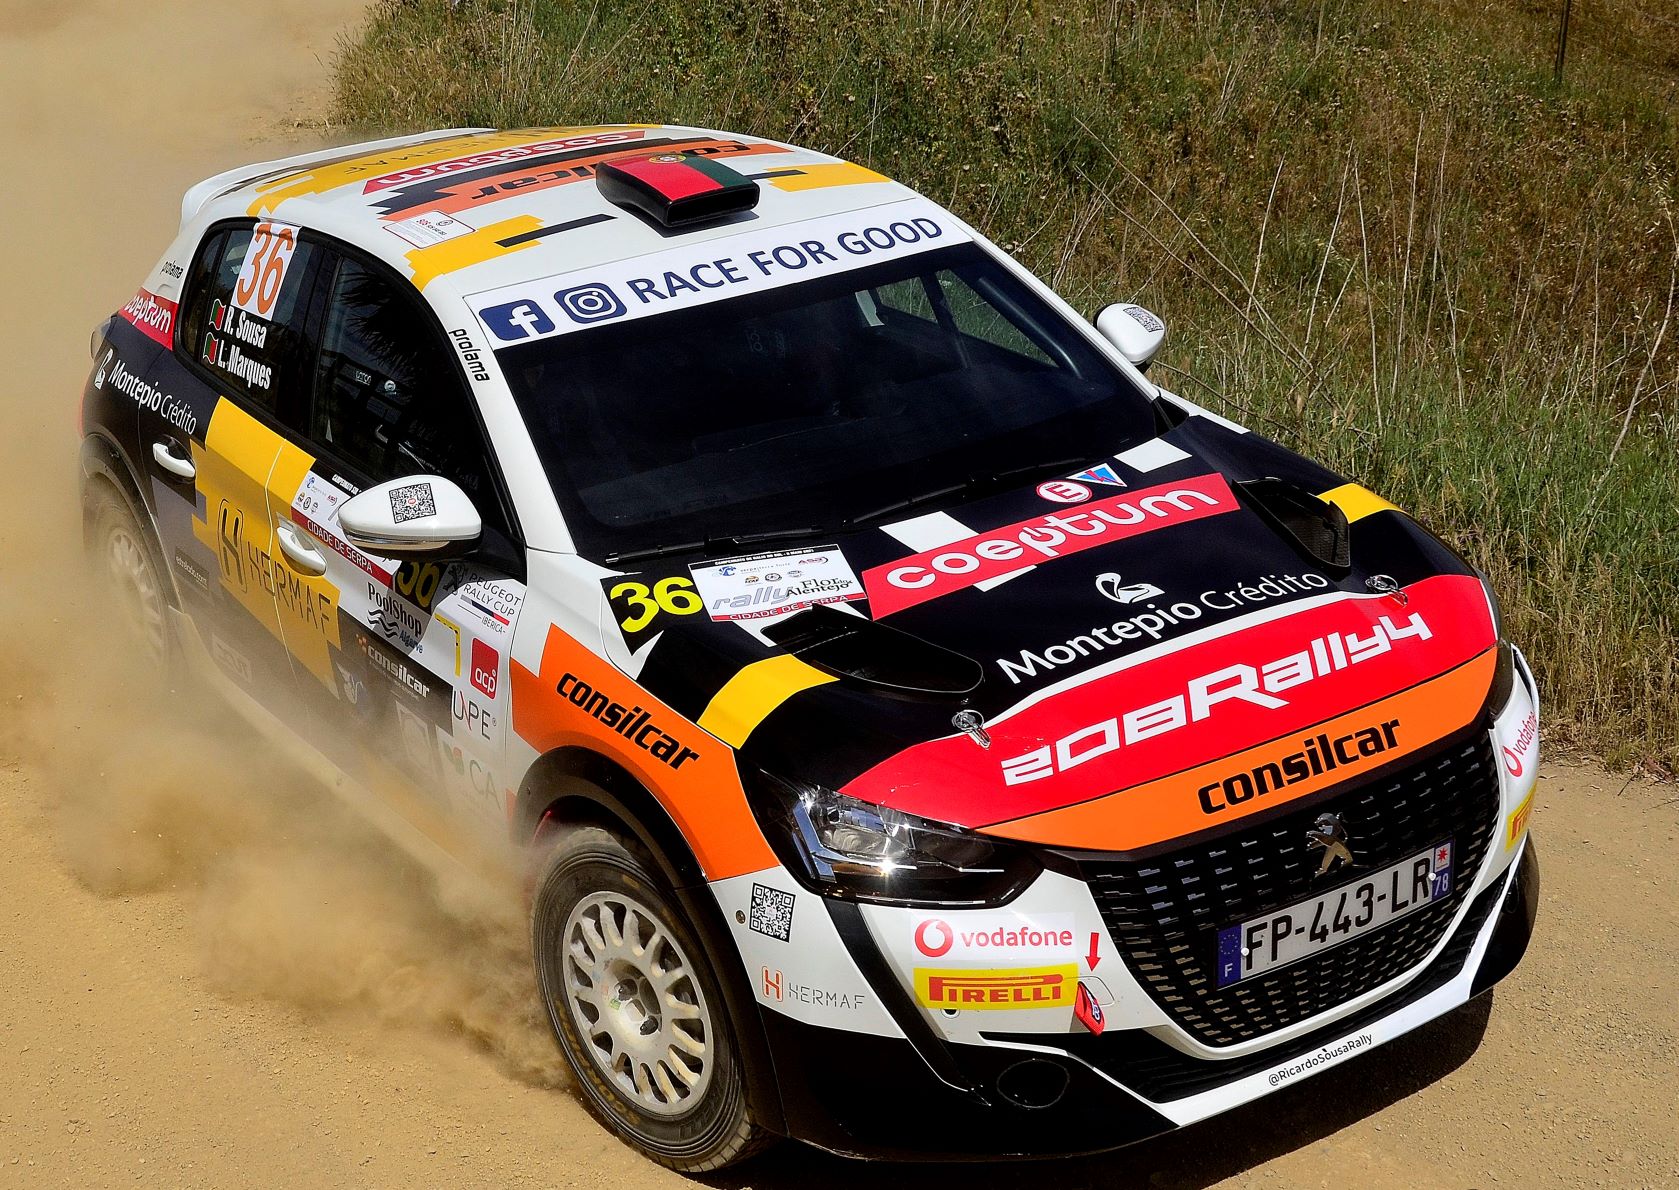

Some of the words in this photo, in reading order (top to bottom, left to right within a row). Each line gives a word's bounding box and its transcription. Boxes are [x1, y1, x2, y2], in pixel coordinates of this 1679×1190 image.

[236, 223, 295, 316] 36
[626, 257, 749, 304] RACE
[748, 239, 838, 279] FOR
[837, 217, 943, 256] GOOD
[224, 306, 235, 335] R.
[236, 311, 267, 349] Sousa
[218, 340, 226, 369] L.
[227, 344, 272, 390] Marques
[448, 329, 490, 381] prolama
[108, 360, 162, 412] Montepio
[160, 394, 197, 435] Crédito
[307, 519, 333, 547] CIDADE
[334, 538, 345, 555] DE
[346, 546, 373, 574] SERPA
[886, 489, 1220, 589] coeptum
[248, 540, 331, 634] HERMAF
[464, 583, 494, 605] RALLY
[493, 601, 515, 616] CUP
[470, 573, 522, 606] PEUGEOT
[610, 577, 703, 633] 36
[713, 585, 793, 610] rally
[785, 583, 850, 597] Alentejo
[801, 577, 840, 589] Flor
[368, 581, 422, 639] PoolShop
[729, 608, 779, 620] CIDADE
[782, 604, 799, 612] DE
[997, 599, 1202, 686] Montepio
[1200, 570, 1328, 611] Crédito
[367, 645, 430, 698] consilcar
[474, 667, 496, 693] acp
[556, 672, 699, 770] consilcar
[1198, 719, 1400, 815] consilcar
[1434, 872, 1449, 896] 78
[960, 925, 1073, 948] vodafone
[1245, 857, 1431, 972] FP-443-LR
[788, 983, 866, 1010] HERMAF
[929, 974, 1063, 1003] PIRELLI
[1224, 962, 1234, 979] F
[1268, 1032, 1374, 1087] @RicardoSousaRally
